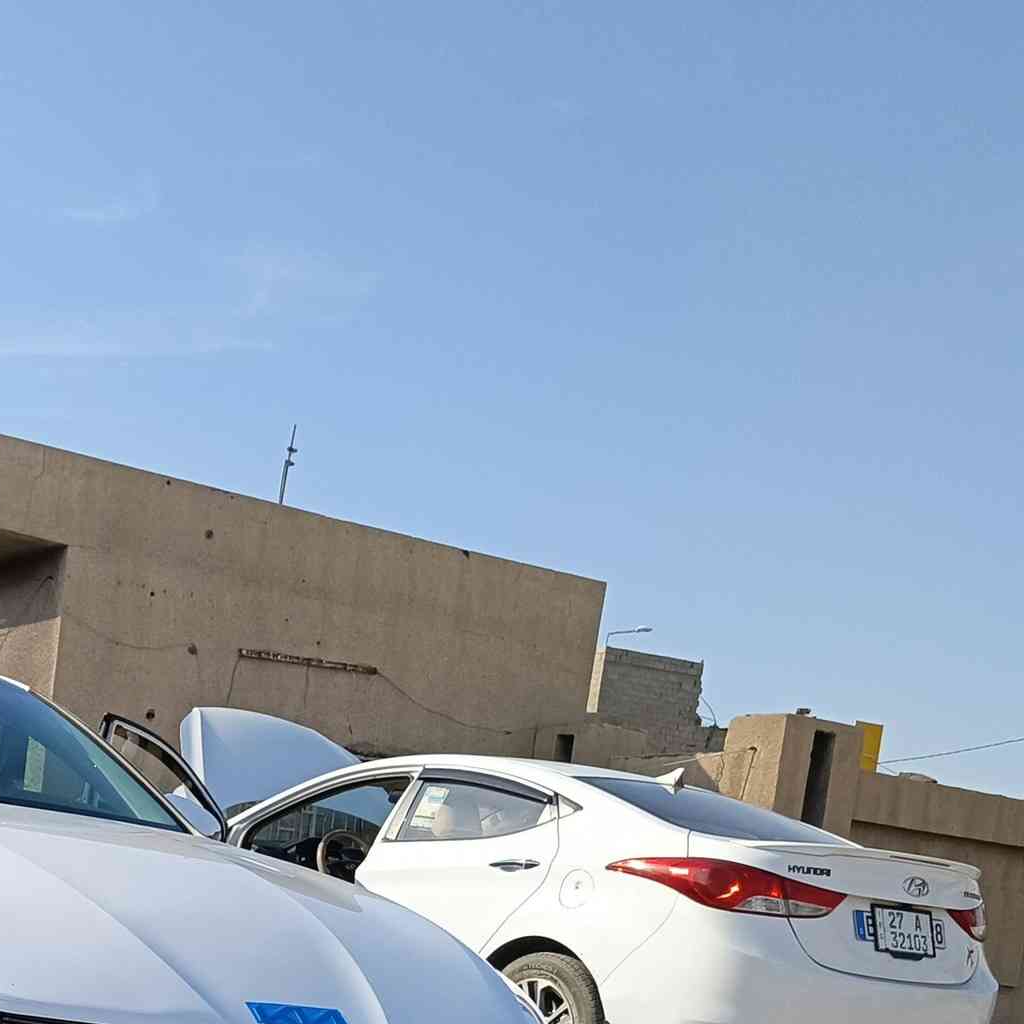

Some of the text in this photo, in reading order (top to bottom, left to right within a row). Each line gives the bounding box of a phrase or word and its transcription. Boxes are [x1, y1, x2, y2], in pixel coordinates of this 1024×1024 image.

[787, 863, 831, 877] HYUNDAI
[888, 911, 904, 930] 27
[914, 914, 923, 933] A
[890, 931, 929, 953] 32103
